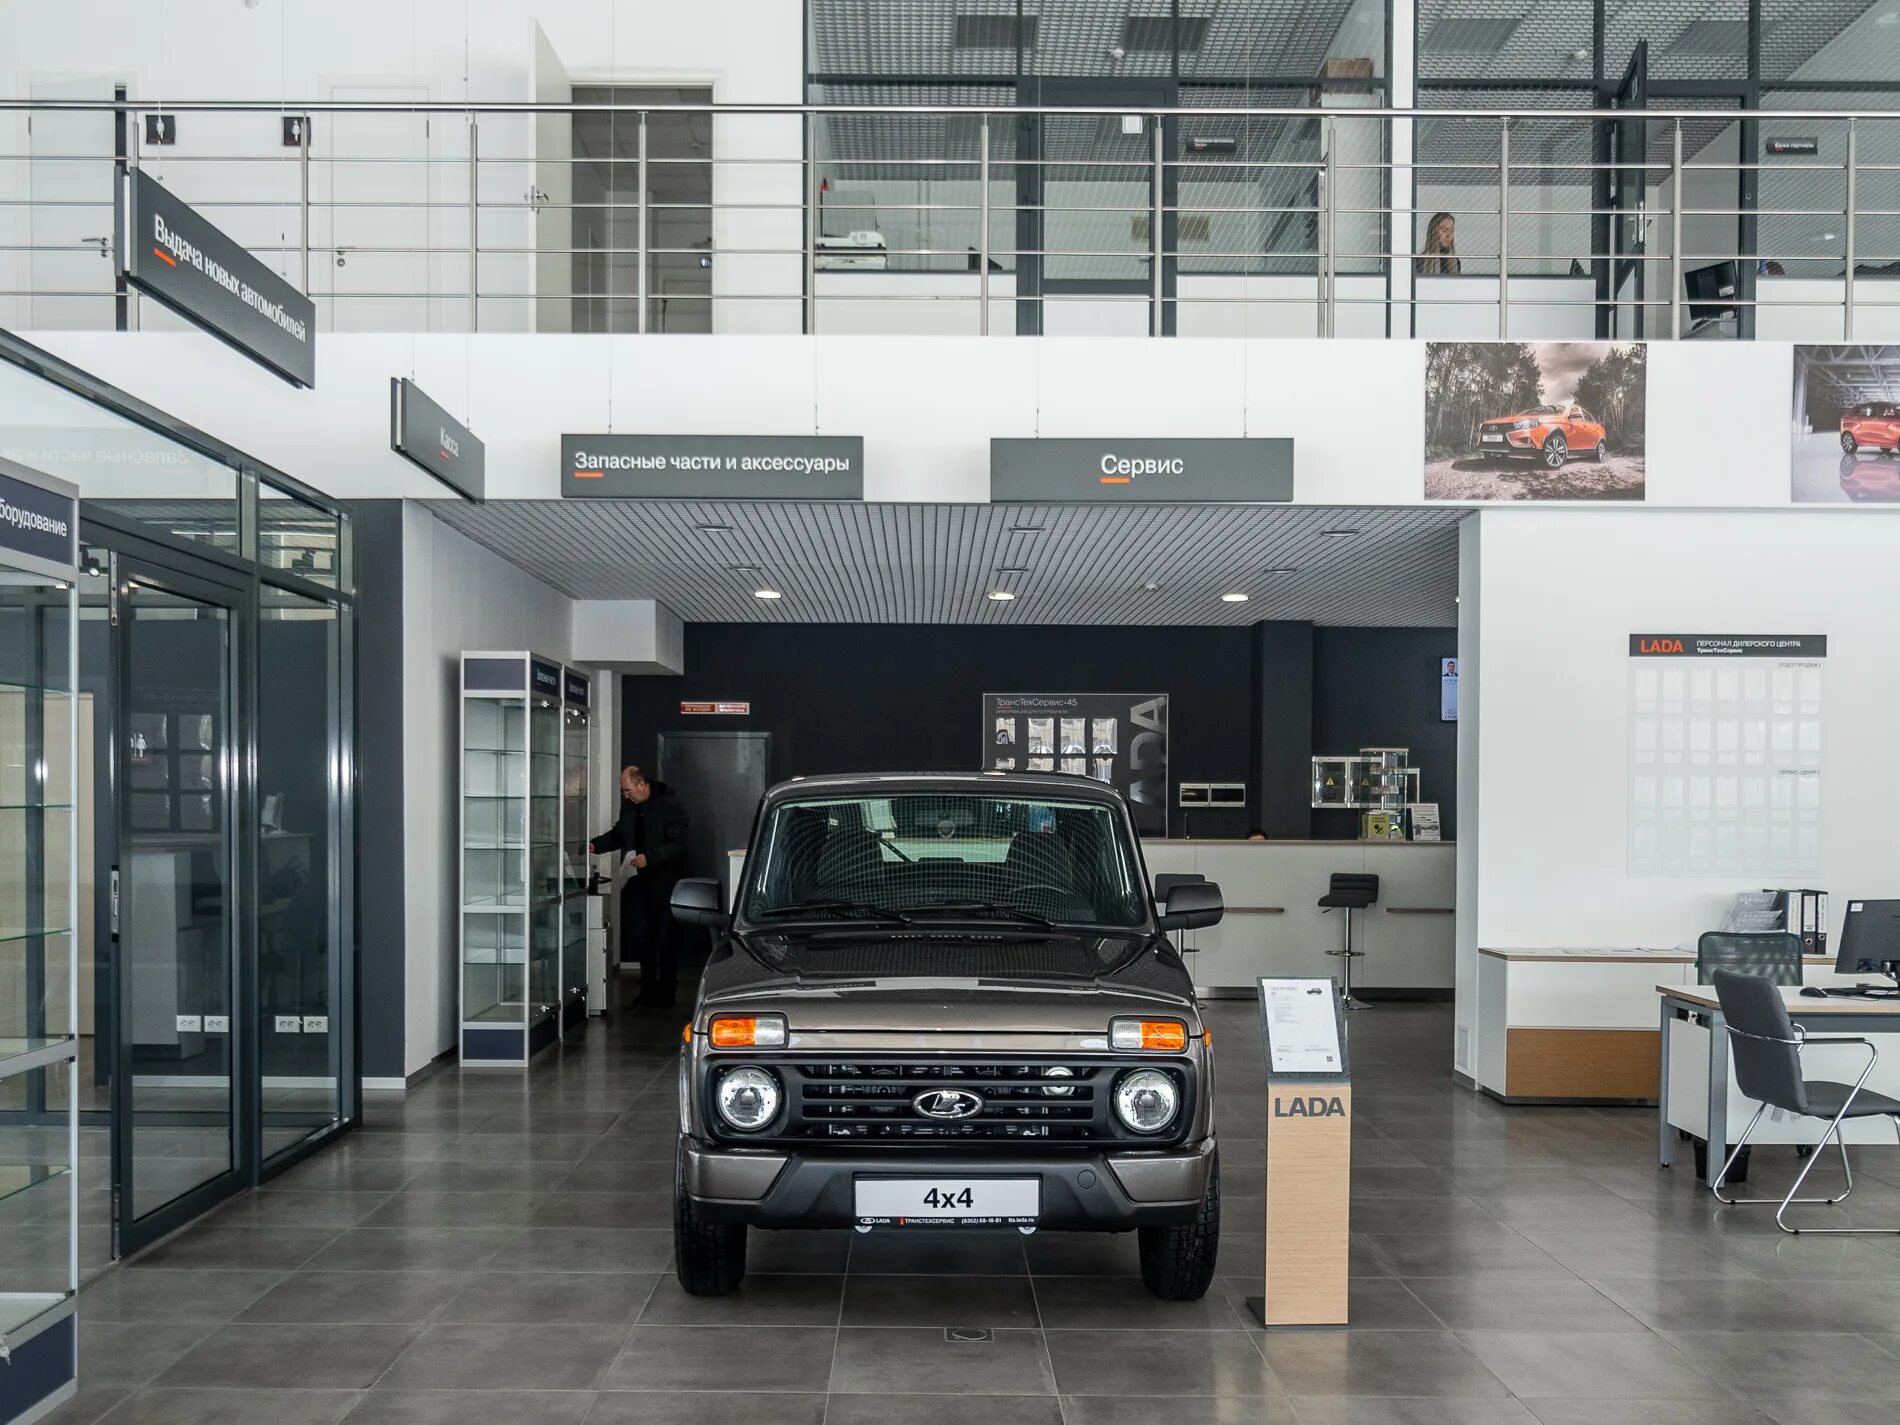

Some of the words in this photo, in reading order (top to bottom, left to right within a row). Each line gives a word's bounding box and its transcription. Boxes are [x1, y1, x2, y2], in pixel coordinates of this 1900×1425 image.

[154, 212, 203, 272] Выдача
[204, 255, 240, 298] новых
[240, 283, 306, 343] автомобилей
[440, 425, 459, 458] Касса
[574, 451, 666, 470] Запасные
[670, 455, 721, 471] части
[725, 457, 738, 471] и
[741, 456, 850, 475] аксессуары
[1101, 453, 1184, 479] Сервис
[0, 498, 68, 537] борудование
[1640, 639, 1684, 653] LADA
[1696, 639, 1731, 648] ПЕРСОНАЛ
[1732, 640, 1777, 648] ДИЛЕРСКОГО
[1778, 640, 1802, 648] ЦЕНТРА
[996, 698, 1078, 707] ТрансТехСервис-45
[1274, 1096, 1346, 1118] LADA
[923, 1187, 974, 1209] 4x4
